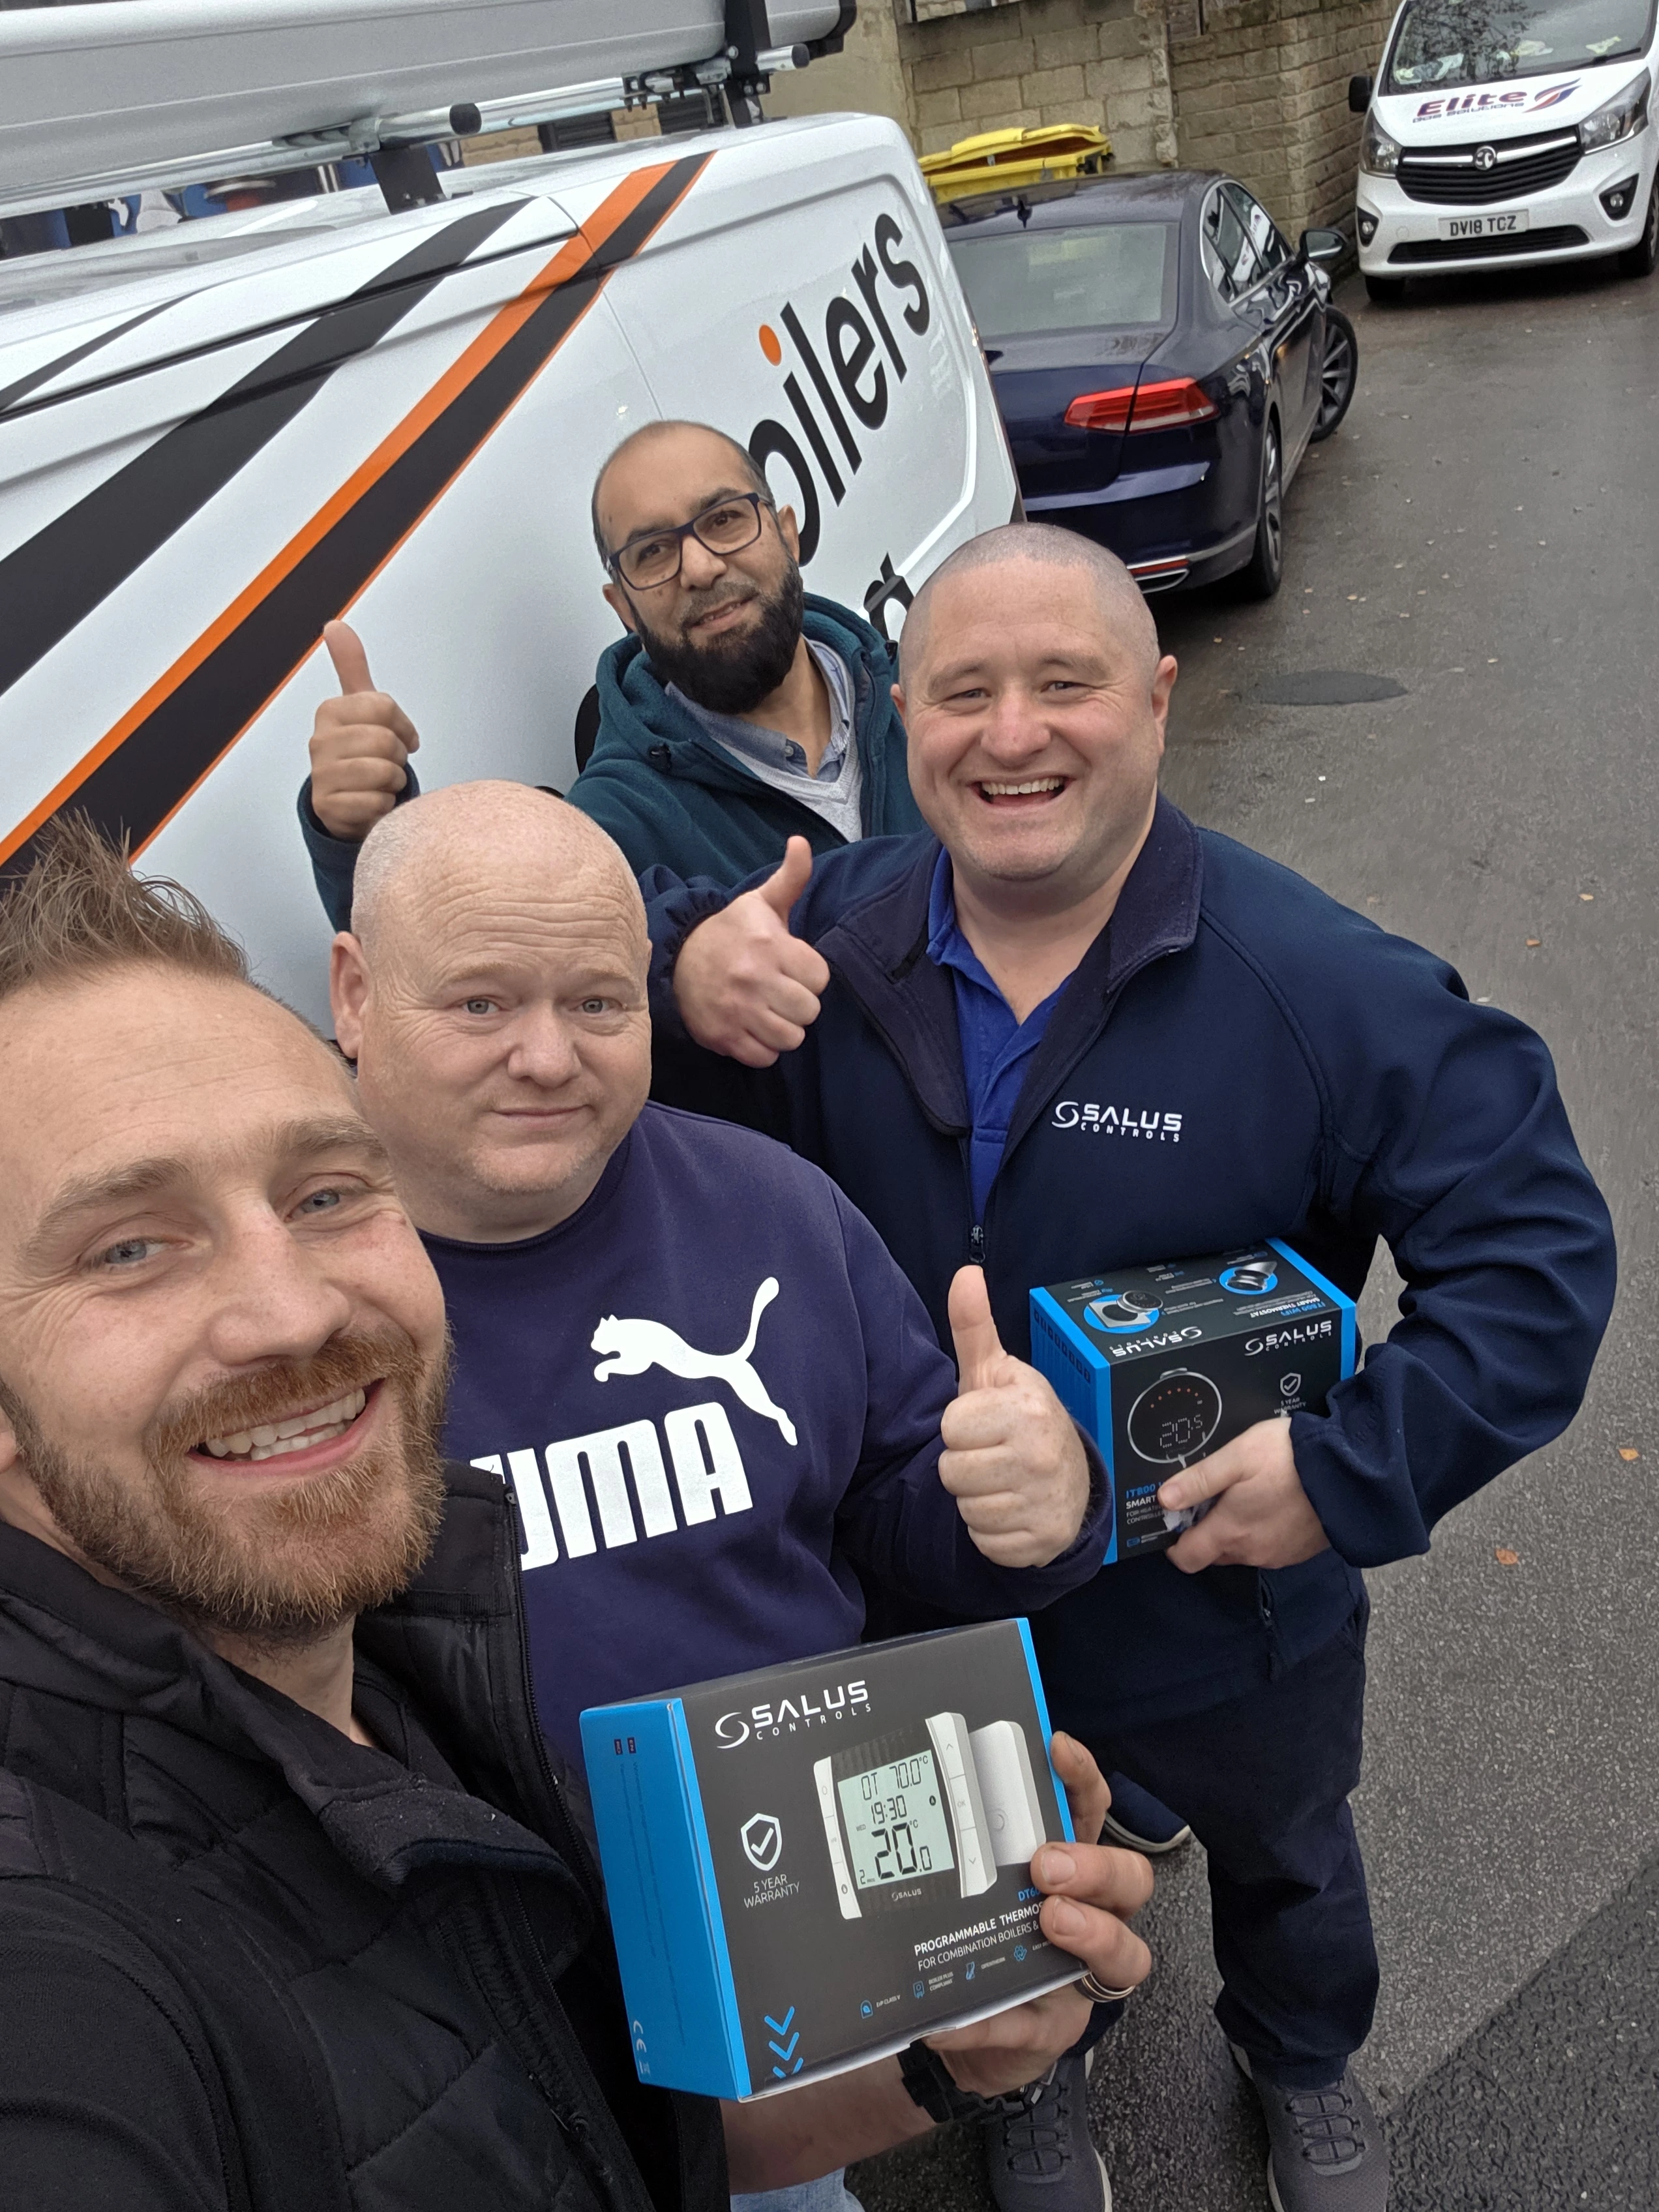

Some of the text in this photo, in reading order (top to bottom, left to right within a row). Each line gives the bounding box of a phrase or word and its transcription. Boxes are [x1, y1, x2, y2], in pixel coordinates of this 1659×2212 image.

[1417, 91, 1527, 117] Elite
[1450, 215, 1516, 236] DV18 TCZ
[749, 213, 930, 567] oilers
[1081, 1103, 1182, 1132] SALUS
[1081, 1122, 1180, 1143] CONTROLS
[1112, 1334, 1183, 1357] SALUS
[1265, 1331, 1332, 1351] CONTROLS
[1266, 1320, 1332, 1346] SALUS
[470, 1401, 753, 1571] UMA
[1126, 1494, 1156, 1510] SMART
[751, 1680, 869, 1729] SALUS
[756, 1703, 871, 1741] CONTROLS
[871, 1794, 908, 1825] 19:30
[743, 1881, 800, 1909] WARRANTY
[753, 1874, 788, 1894] 5 YEAR
[898, 1888, 922, 1898] SALUS
[914, 1918, 997, 1956] PROGRAMMABLE
[918, 1920, 1039, 1972] FOR COMBINATION BOILERS &
